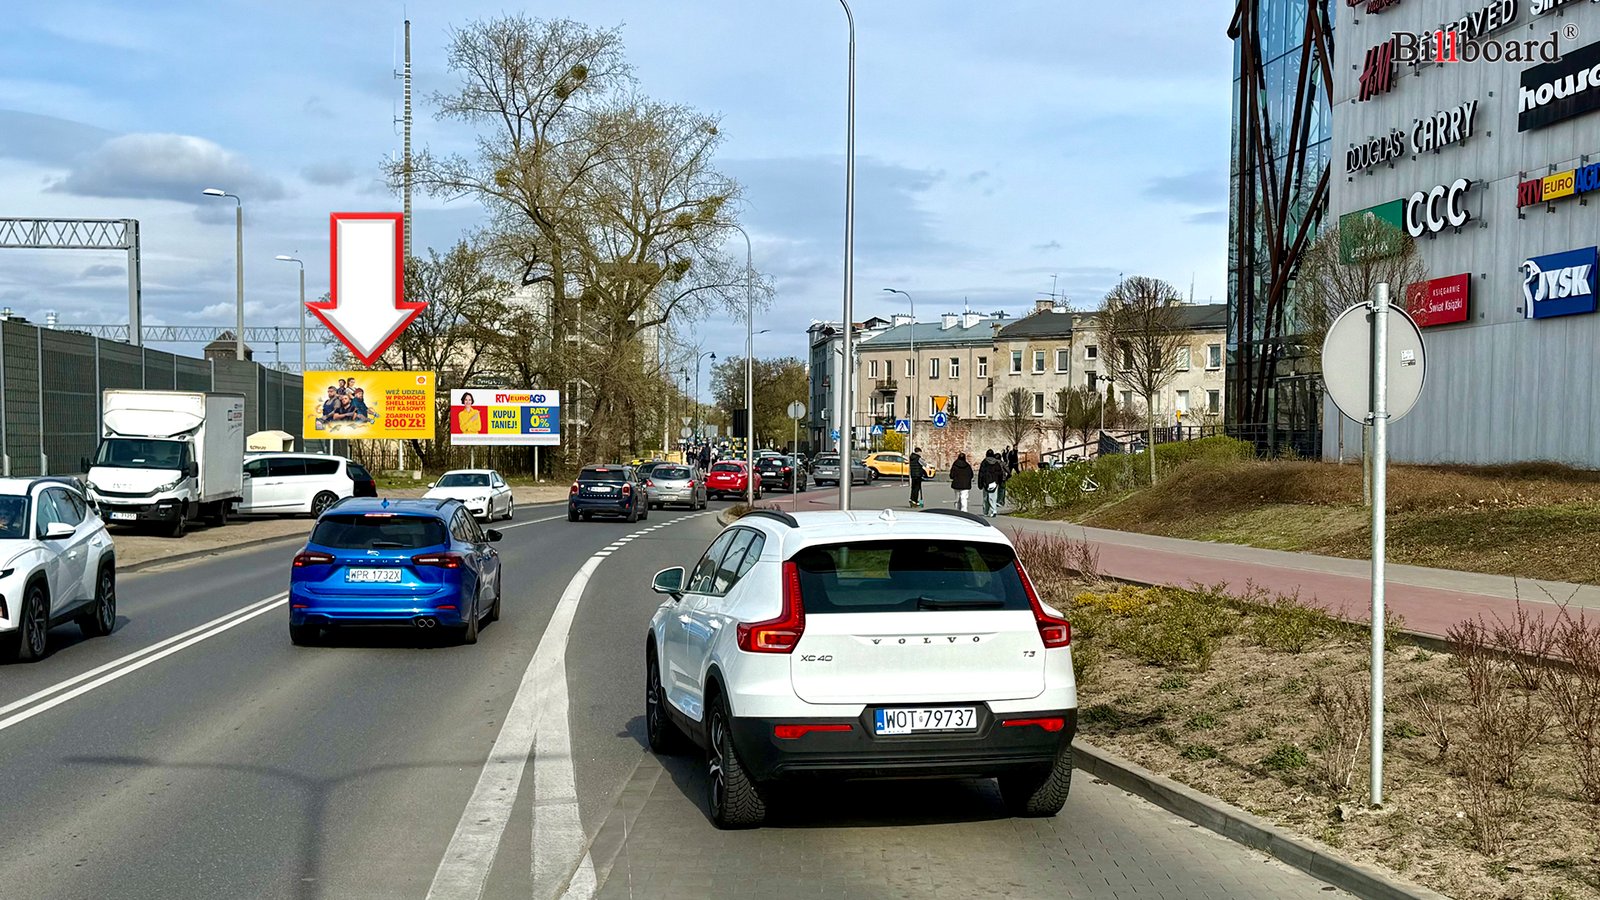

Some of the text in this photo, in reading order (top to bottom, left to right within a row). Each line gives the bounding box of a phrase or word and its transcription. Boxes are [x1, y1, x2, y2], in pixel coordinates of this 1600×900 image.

[1359, 38, 1394, 101] H&M
[1410, 100, 1478, 153] CARRY
[1347, 131, 1405, 173] DOUGLAS
[1406, 178, 1472, 238] CCC
[1535, 264, 1593, 302] JYSK
[385, 418, 406, 428] 800
[493, 410, 516, 419] KUPUJ
[491, 420, 517, 429] TANIEJ!
[351, 570, 400, 580] WPR 1732X
[872, 636, 981, 645] VOLVO
[885, 710, 917, 728] WOT
[923, 709, 974, 728] 79737
